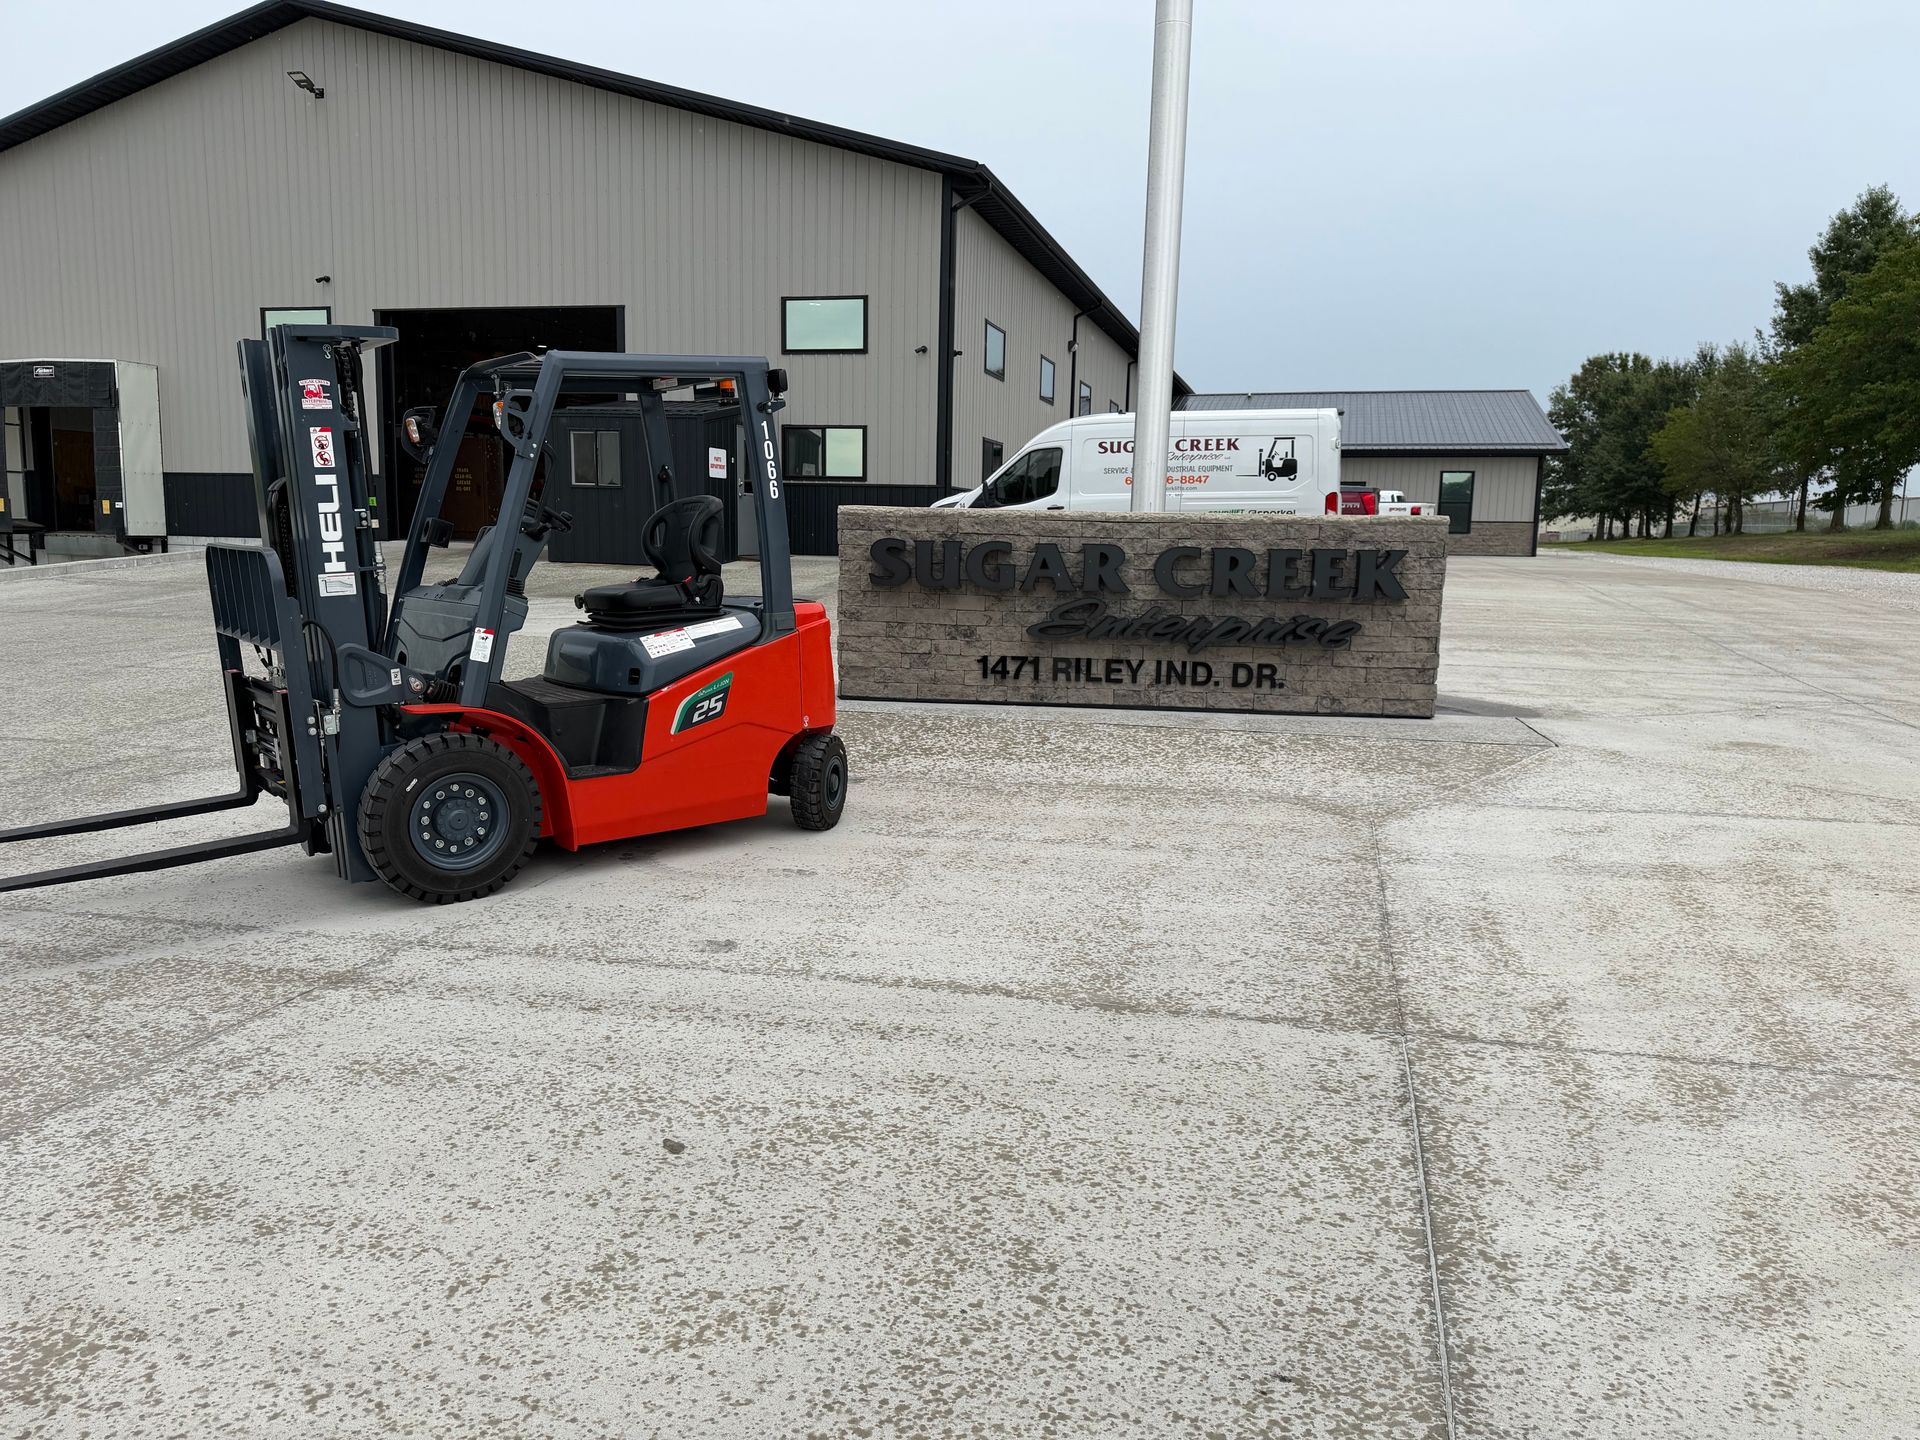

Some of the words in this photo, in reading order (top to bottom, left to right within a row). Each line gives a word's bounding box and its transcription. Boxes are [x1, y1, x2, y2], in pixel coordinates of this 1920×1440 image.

[761, 421, 779, 499] 1066
[1098, 440, 1135, 454] SUG
[1175, 438, 1240, 452] CREEK
[1103, 467, 1128, 475] SERVICE
[315, 474, 346, 572] HELI
[869, 538, 1131, 593] SUGAR
[1154, 546, 1410, 599] CREEK
[1026, 599, 1362, 654] Enterprise
[977, 655, 1040, 681] 1471
[1052, 657, 1145, 684] RILEY
[1155, 660, 1220, 687] IND.
[1231, 663, 1285, 689] DR.
[692, 693, 724, 723] 25
